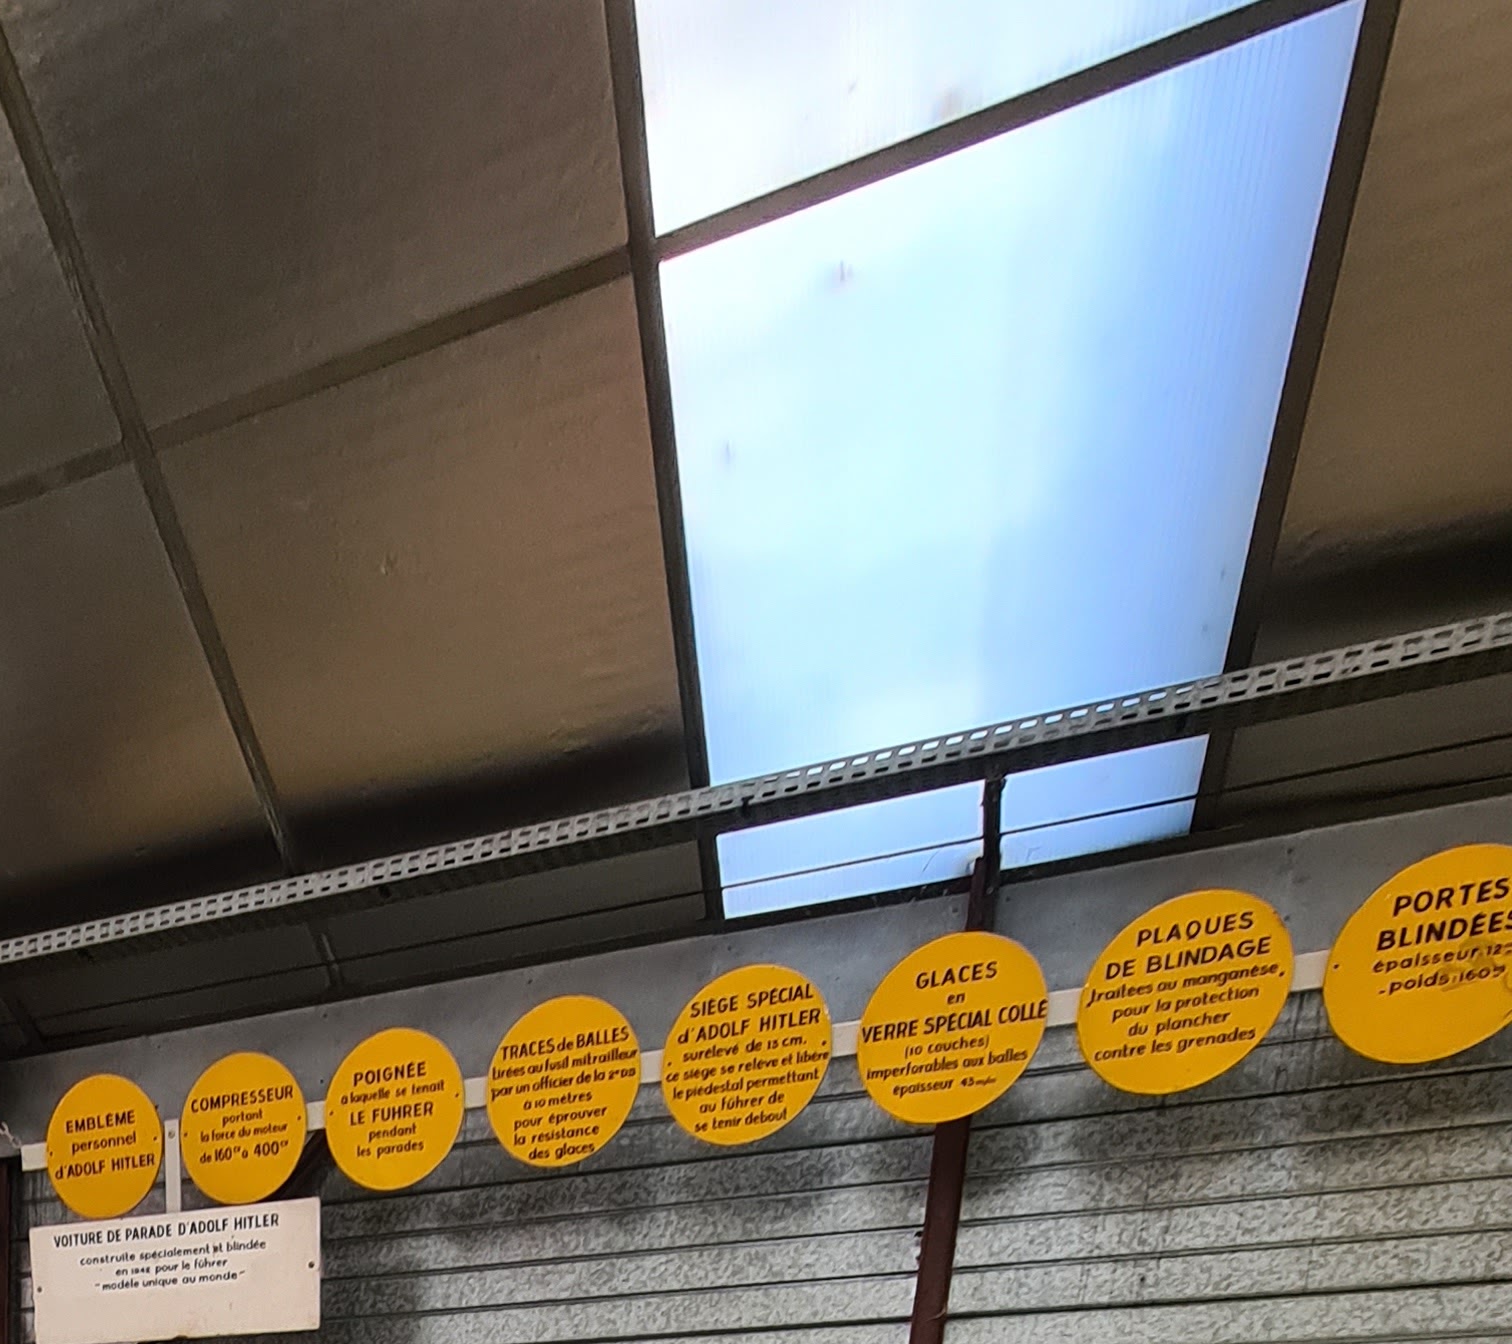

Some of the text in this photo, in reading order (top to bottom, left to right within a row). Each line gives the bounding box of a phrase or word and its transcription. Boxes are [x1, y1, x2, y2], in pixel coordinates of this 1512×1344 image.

[1392, 877, 1510, 918] PORTES
[1136, 911, 1254, 948] PLAQUES
[1105, 936, 1272, 981] DE BLINDAGE
[916, 961, 998, 989] GLACES
[1156, 979, 1178, 992] au
[947, 992, 966, 1006] en
[1111, 986, 1260, 1024] pour la protection
[677, 1008, 821, 1044] d'ADOLF HITLER
[862, 1019, 919, 1044] VERRE
[1128, 1011, 1232, 1037] du plancher
[501, 1026, 630, 1061] TRACES de BALLES
[745, 1038, 763, 1053] de
[1093, 1027, 1256, 1062] contre les grenades
[527, 1063, 543, 1075] au
[544, 1056, 569, 1072] fusil
[571, 1048, 638, 1068] mitrailleur
[665, 1071, 680, 1083] ce
[720, 1063, 735, 1075] se
[781, 1054, 794, 1066] et
[866, 1048, 1028, 1081] imperforables aux balles
[350, 1088, 390, 1104] laquelle
[395, 1087, 407, 1098] se
[412, 1079, 444, 1095] tenait
[490, 1086, 512, 1102] par
[515, 1082, 530, 1094] un
[532, 1075, 574, 1092] officier
[576, 1071, 592, 1085] de
[593, 1068, 606, 1082] la
[673, 1086, 684, 1100] le
[746, 1067, 819, 1093] permettant
[191, 1085, 293, 1113] COMPRESSEUR
[699, 1102, 716, 1114] au
[767, 1090, 785, 1105] de
[222, 1108, 263, 1128] portant
[350, 1110, 365, 1126] LE
[514, 1115, 543, 1132] pour
[694, 1107, 788, 1133] se tenir debout
[71, 1130, 136, 1156] personnel
[200, 1123, 288, 1142] la force du moteur
[368, 1122, 416, 1143] pendant
[514, 1132, 526, 1146] la
[111, 1153, 156, 1172] HITLER
[199, 1151, 212, 1164] de
[356, 1140, 424, 1160] les parades
[528, 1142, 595, 1161] des glaces
[53, 1213, 279, 1248] VOITURE DE PARADE D'ADOLF HITLER
[80, 1251, 136, 1266] construite
[115, 1267, 128, 1276] en
[154, 1262, 179, 1275] pour
[181, 1259, 191, 1271] le
[142, 1276, 178, 1288] unique
[182, 1275, 196, 1285] au
